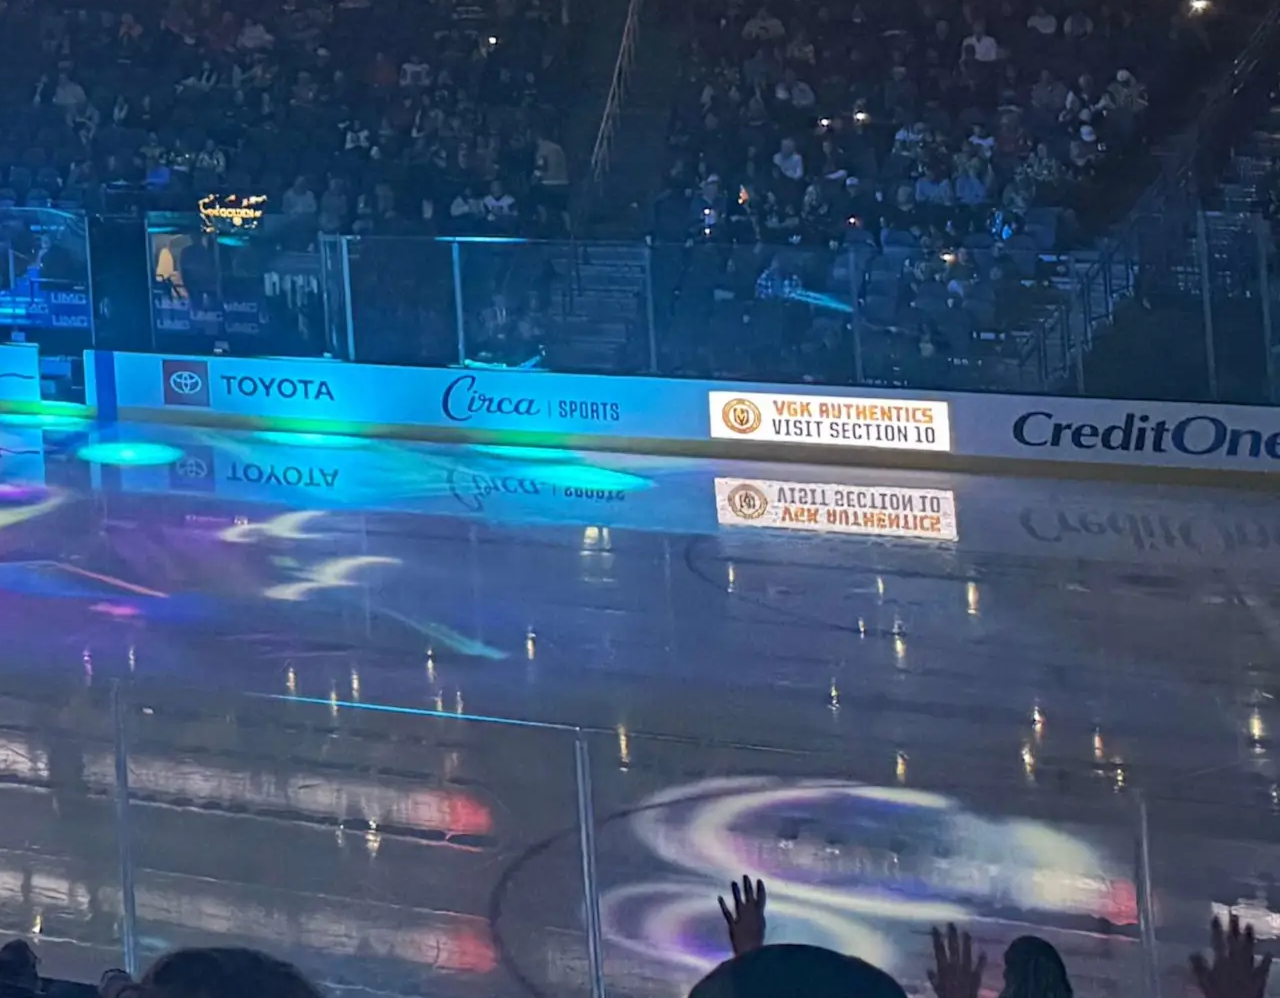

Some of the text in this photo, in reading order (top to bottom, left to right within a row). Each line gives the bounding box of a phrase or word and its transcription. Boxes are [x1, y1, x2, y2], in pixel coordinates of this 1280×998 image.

[220, 374, 336, 401] TOYOTA
[442, 375, 620, 422] Circa SPORTS
[772, 400, 933, 425] VGK AUTHENTICS
[772, 418, 936, 444] VISIT SECTION 10
